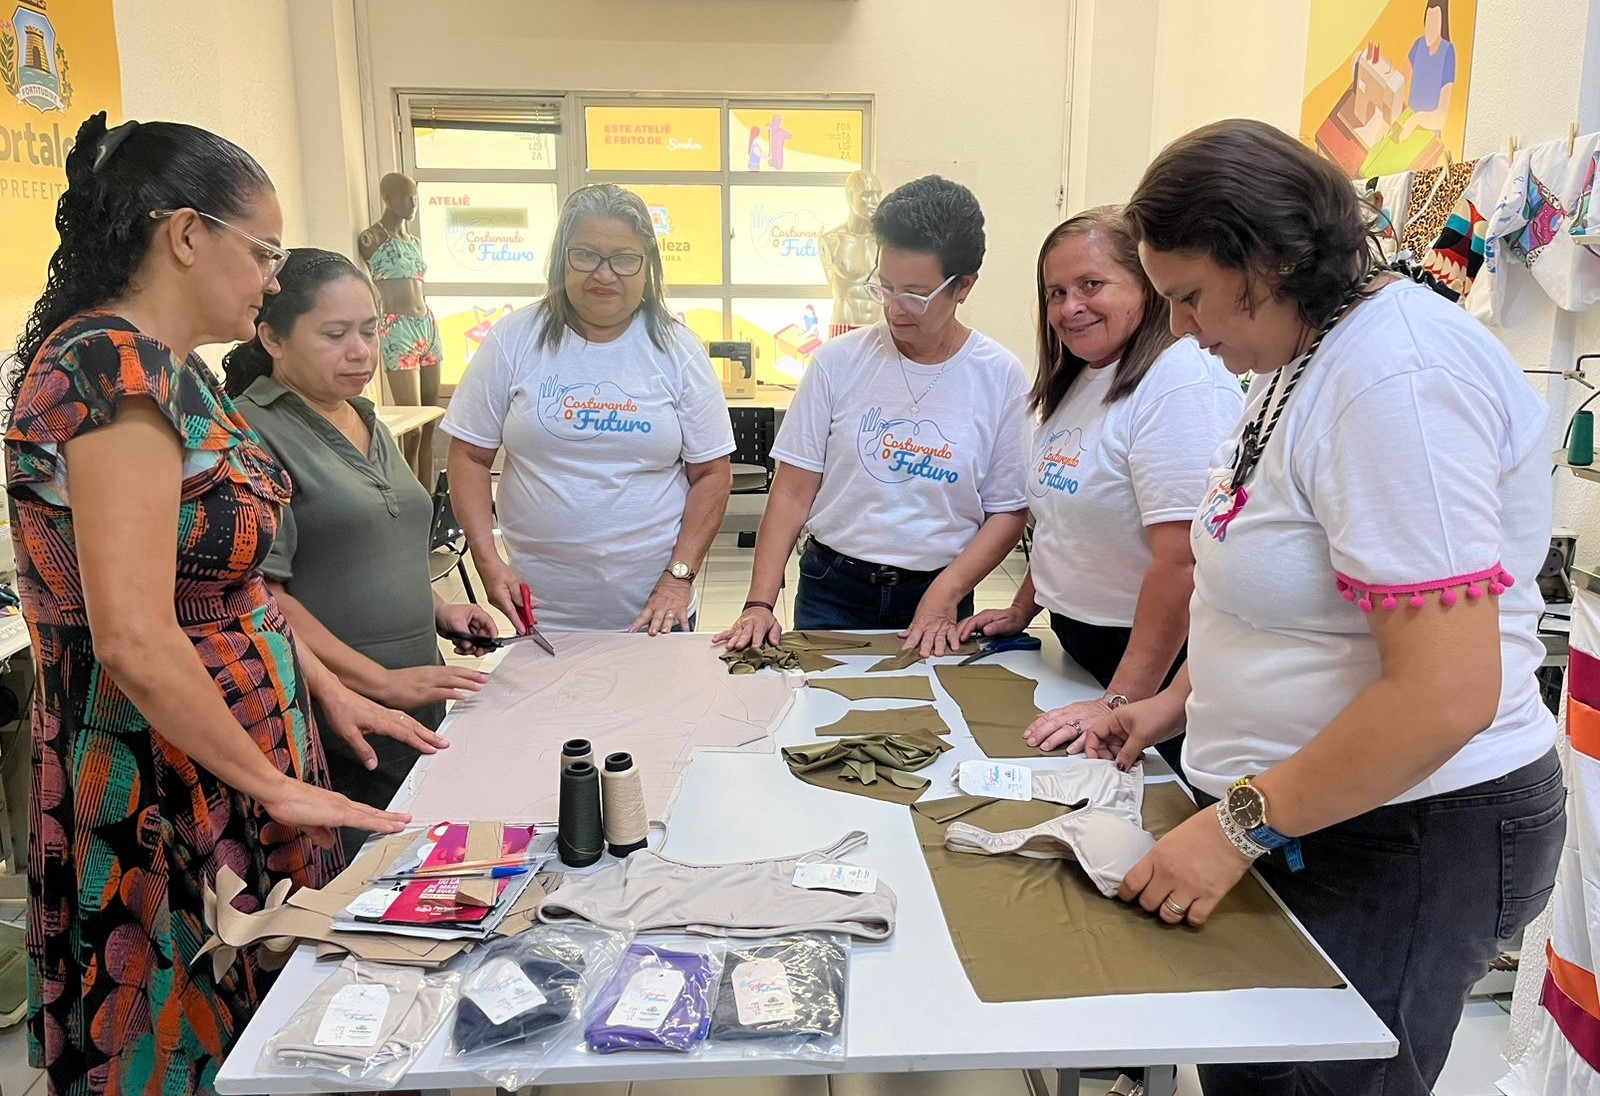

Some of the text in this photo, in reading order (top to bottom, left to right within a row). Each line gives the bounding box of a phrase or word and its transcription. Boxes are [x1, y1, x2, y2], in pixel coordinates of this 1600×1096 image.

[604, 122, 672, 133] ESTE ATELIÊ
[0, 122, 75, 168] ortale
[613, 135, 645, 145] FEITO
[647, 136, 662, 145] DE
[0, 178, 67, 200] PREFEIT
[428, 194, 470, 206] ATELIÊ
[466, 231, 524, 243] Costurando
[771, 225, 825, 238] Costurand
[477, 243, 534, 261] Futuro
[659, 238, 690, 252] leza
[563, 395, 638, 412] Costurando
[573, 409, 652, 433] Futuro
[882, 433, 952, 459] Costurando
[1043, 446, 1081, 468] Costurando
[888, 450, 959, 484] Futuro
[1039, 462, 1079, 495] Futuro
